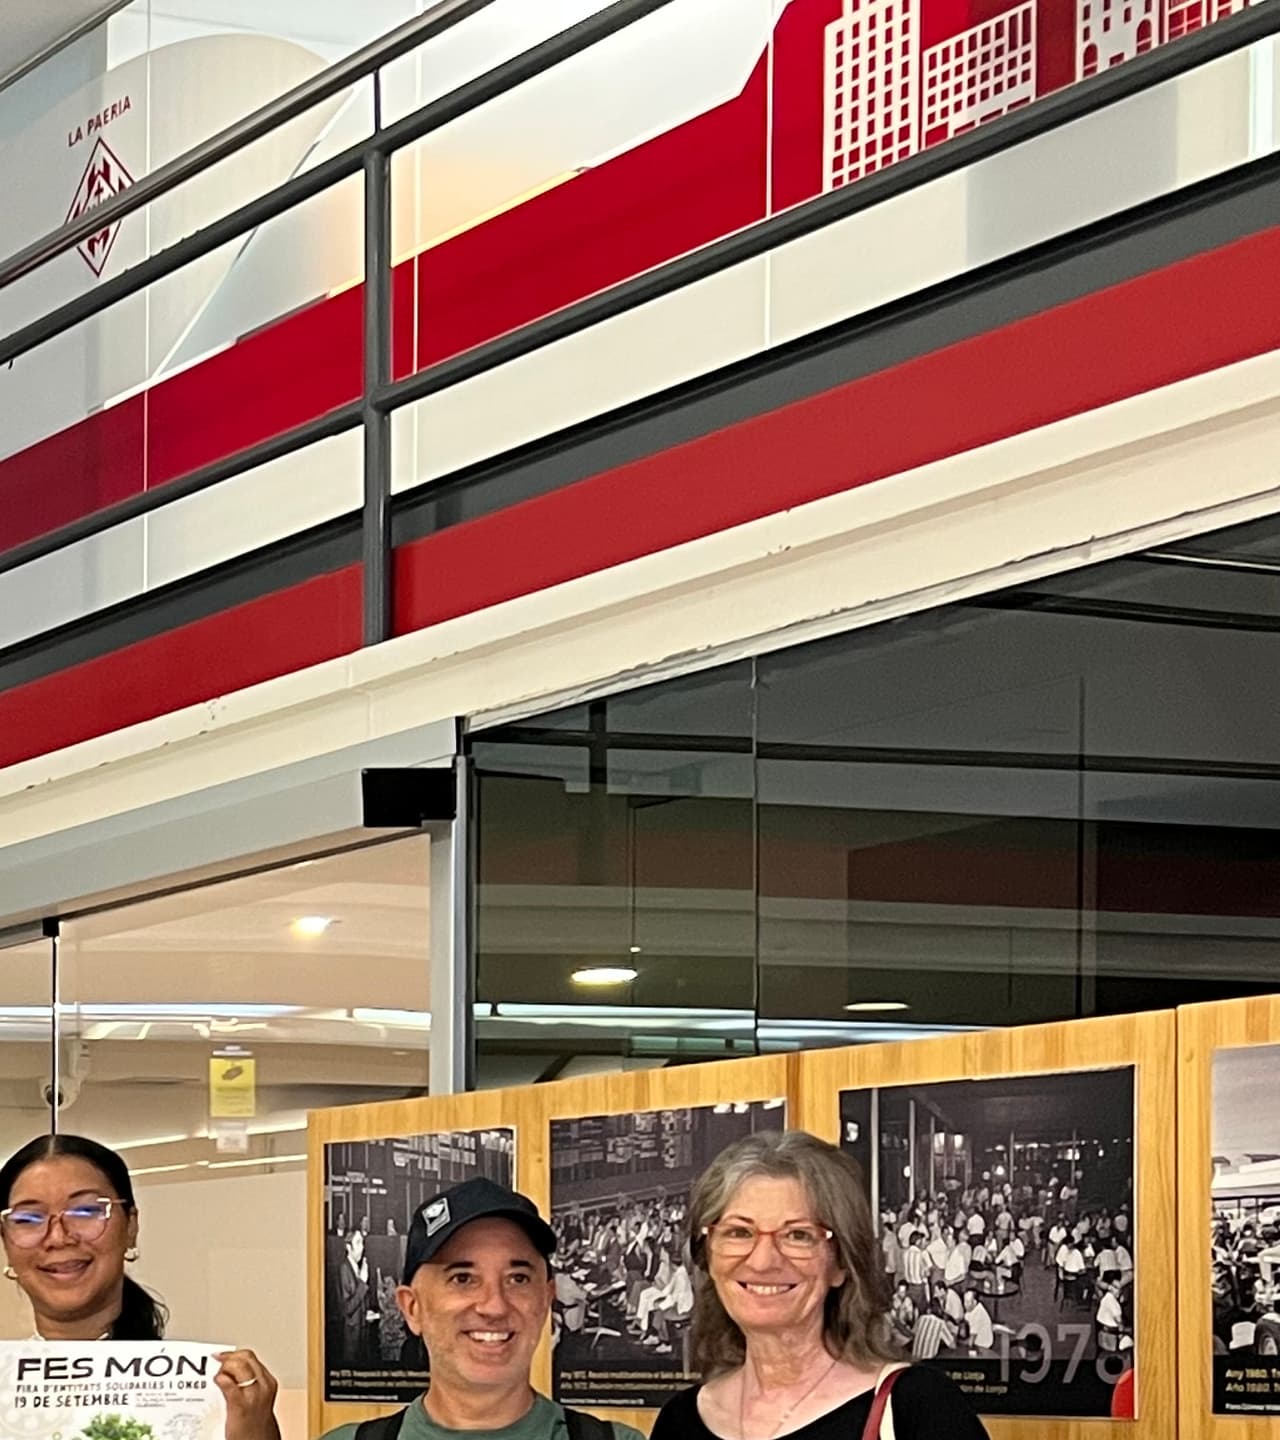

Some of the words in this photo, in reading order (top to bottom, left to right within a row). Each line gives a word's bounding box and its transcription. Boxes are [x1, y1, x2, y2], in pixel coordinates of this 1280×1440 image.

[68, 125, 83, 147] LA
[87, 95, 131, 136] PAERIA
[17, 1357, 94, 1381] FES
[104, 1349, 208, 1378] MÓN
[16, 1384, 39, 1393] FIRA
[14, 1396, 27, 1409] 19
[33, 1395, 50, 1409] DE
[55, 1393, 129, 1408] SETEMBRE
